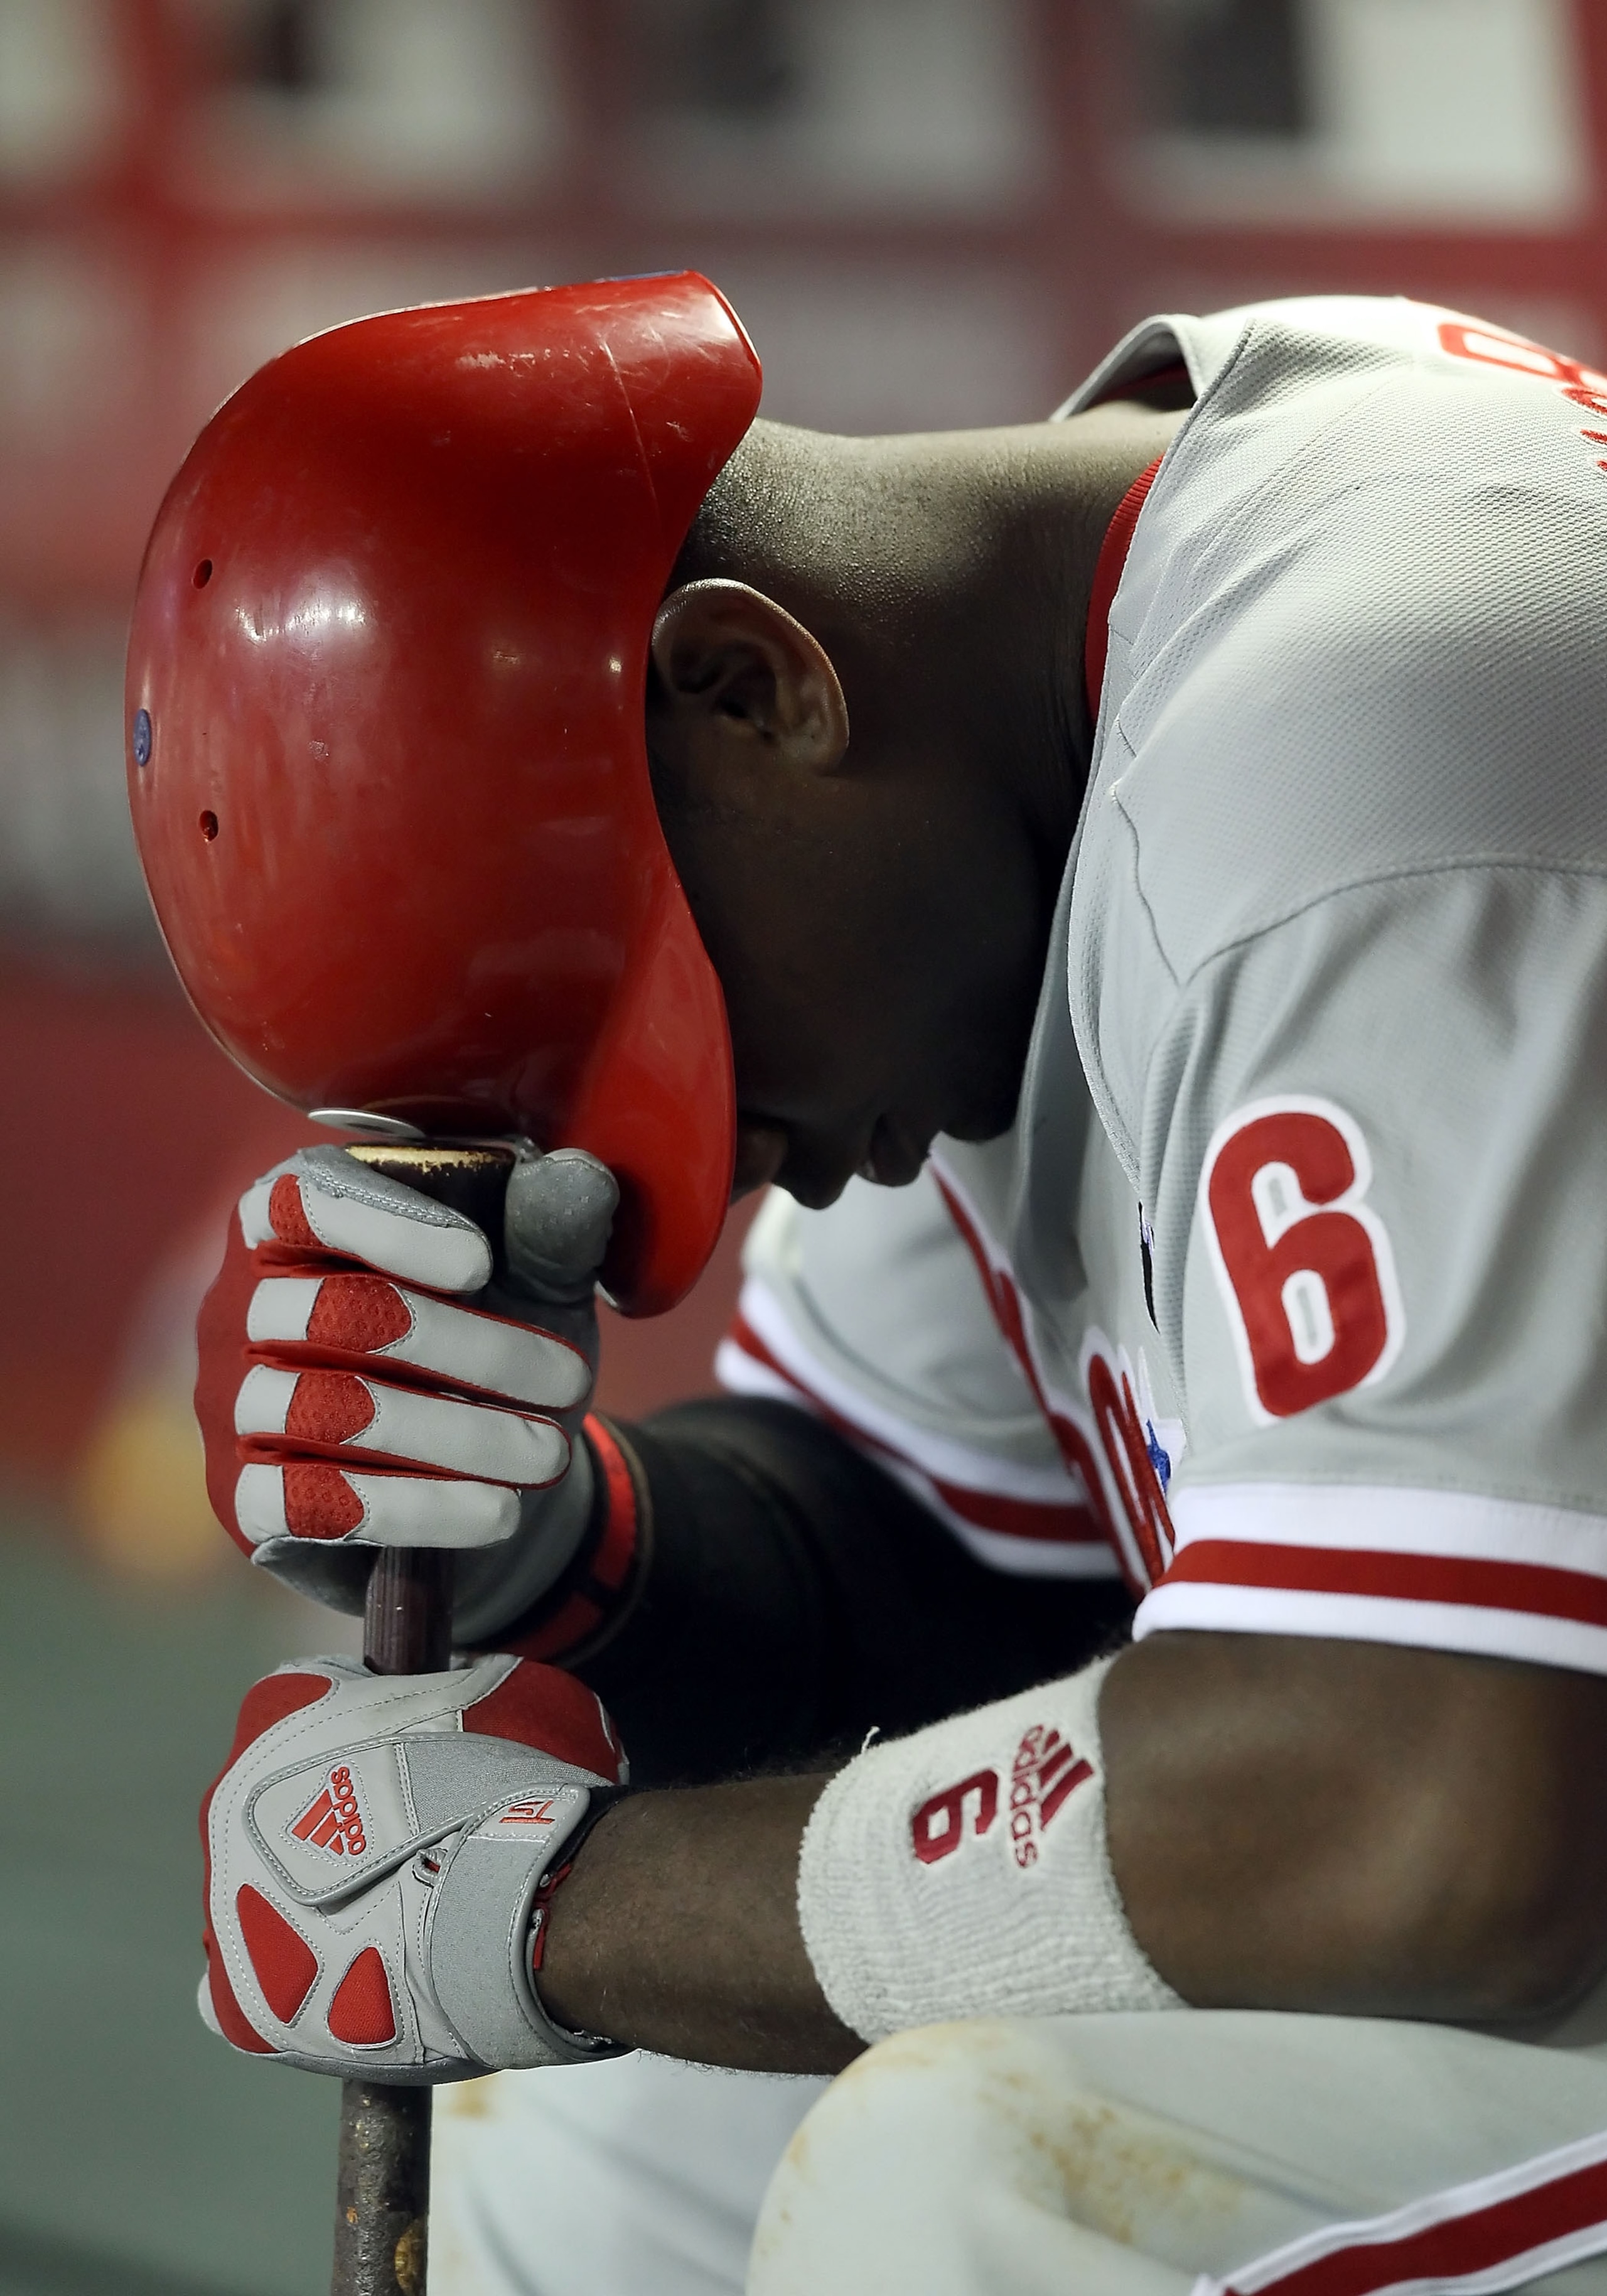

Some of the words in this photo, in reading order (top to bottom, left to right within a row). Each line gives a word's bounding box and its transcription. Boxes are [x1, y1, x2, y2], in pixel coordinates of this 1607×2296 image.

[1205, 1106, 1394, 1421] 6
[331, 1766, 367, 1856] adidas
[912, 1769, 999, 1865] 6
[1009, 1725, 1043, 1868] adidas
